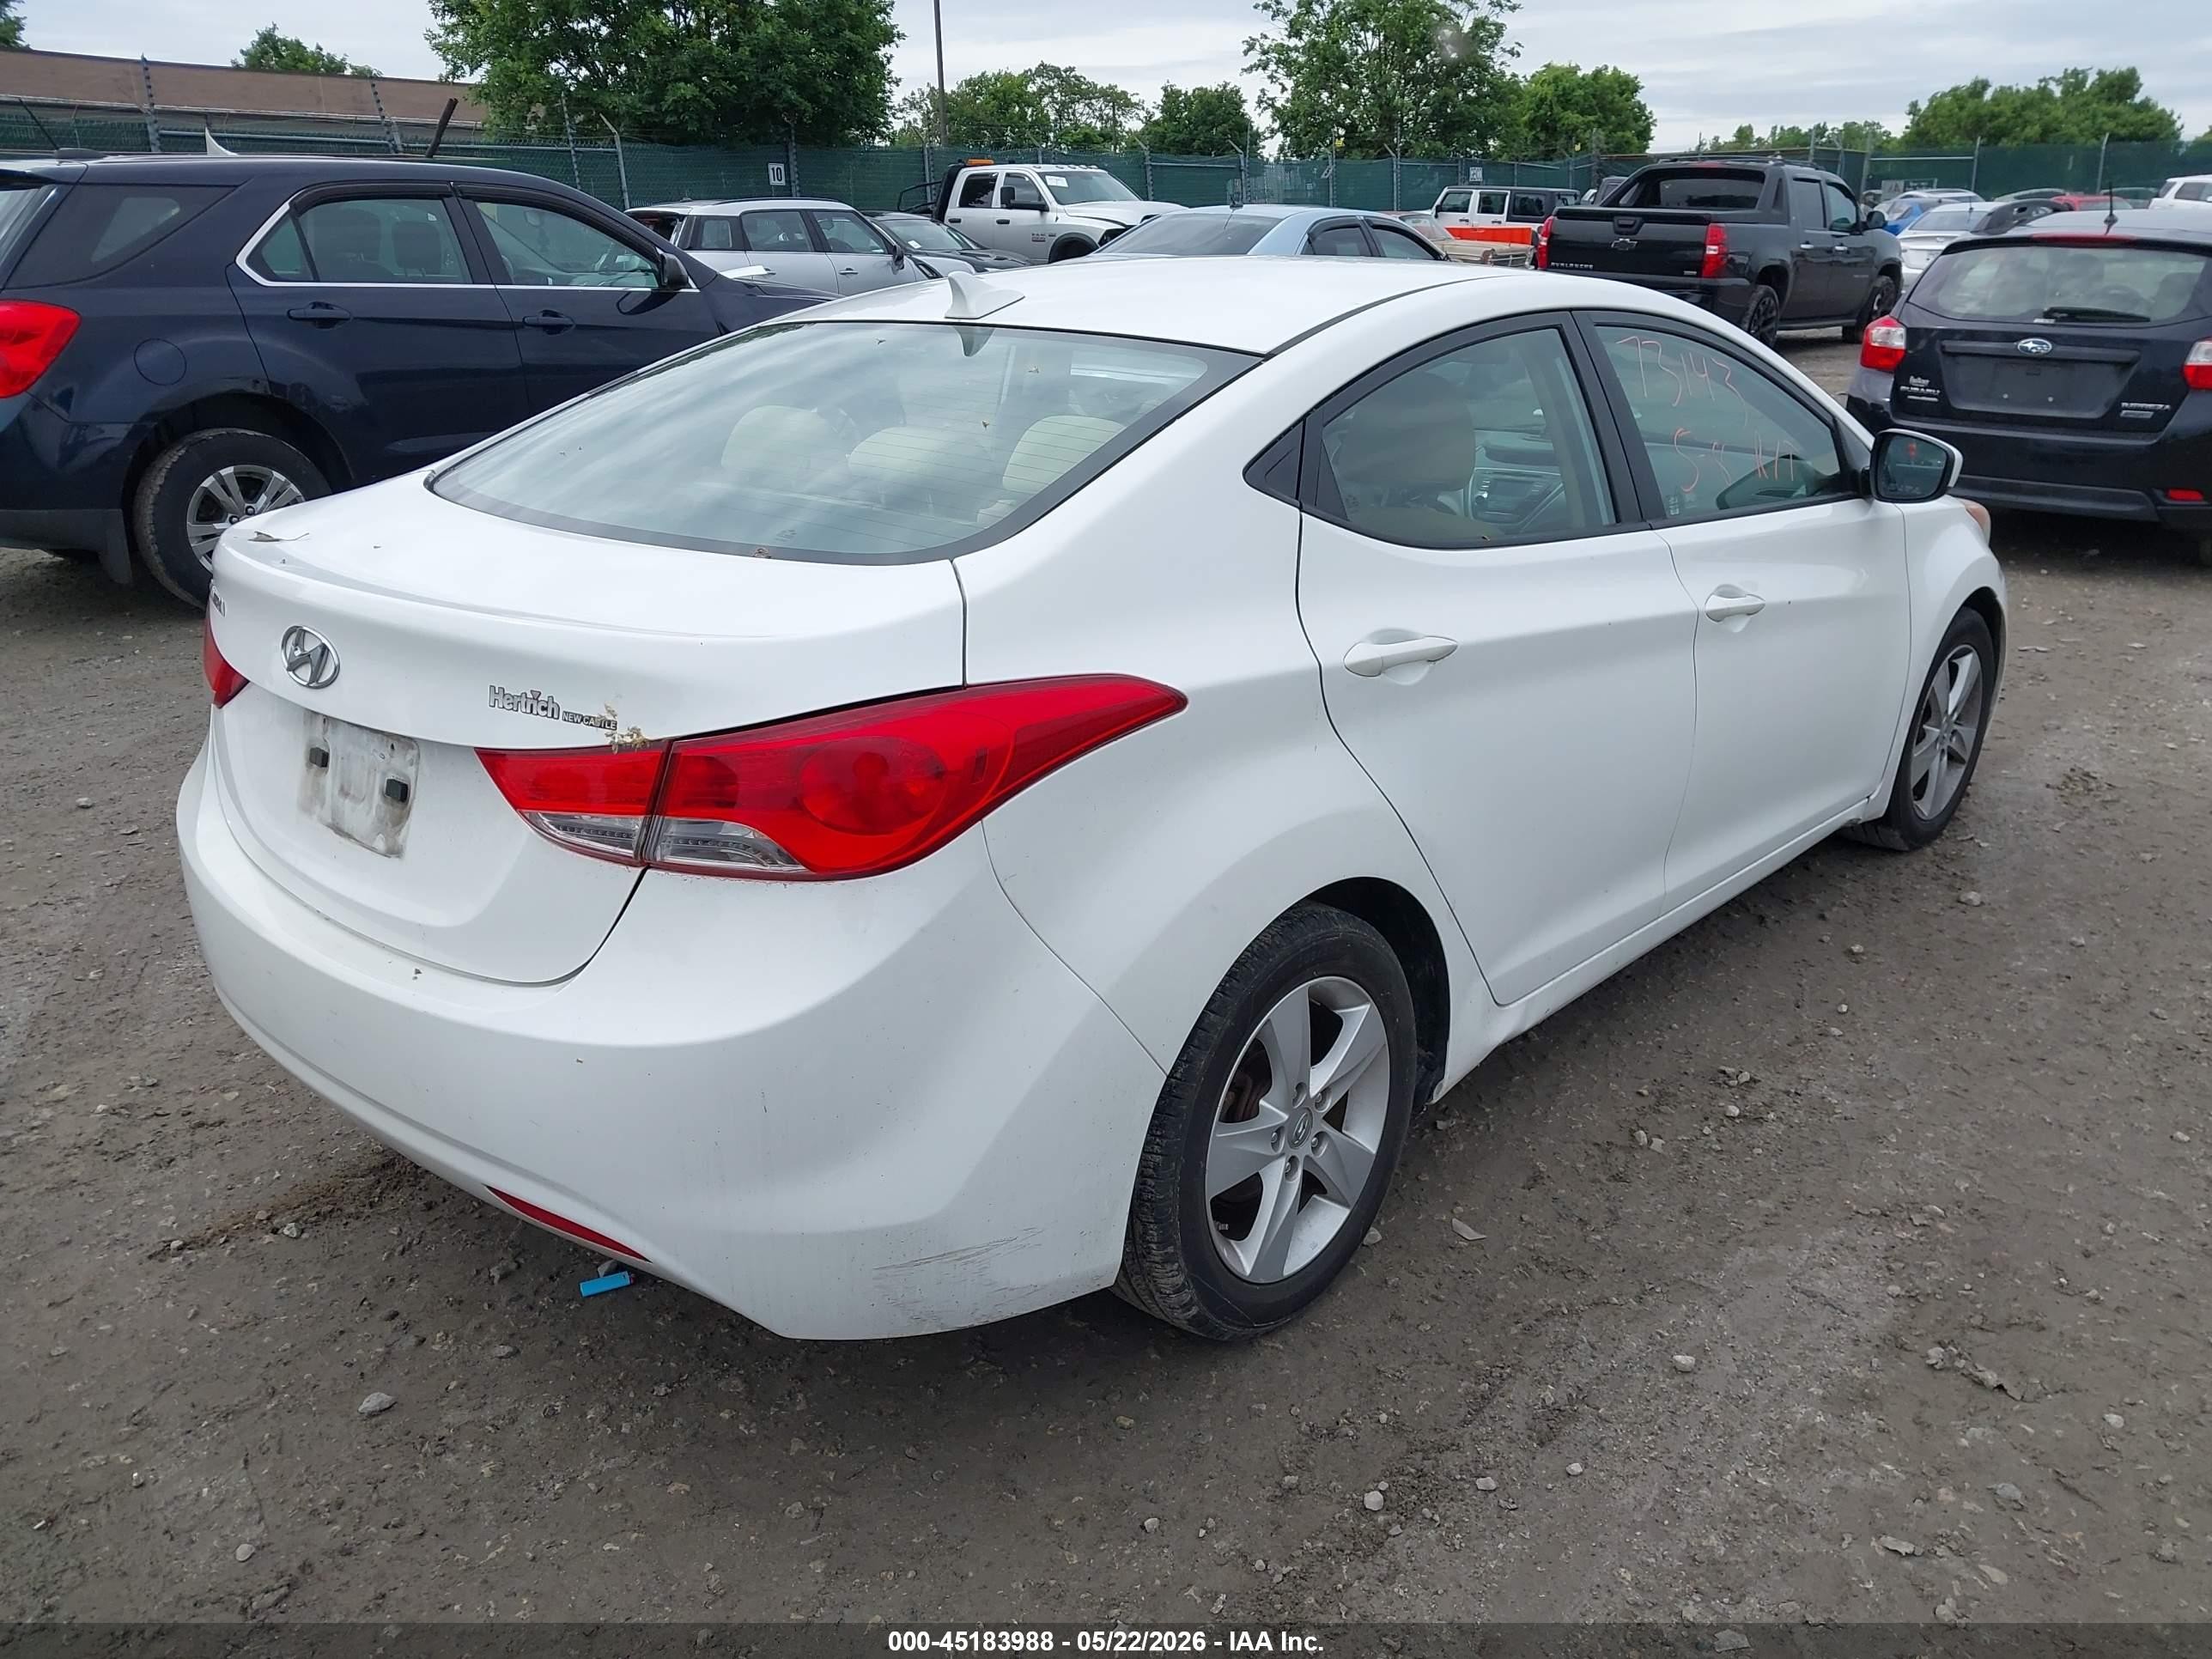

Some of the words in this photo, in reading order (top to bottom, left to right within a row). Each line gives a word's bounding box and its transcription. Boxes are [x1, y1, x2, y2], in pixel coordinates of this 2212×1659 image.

[771, 167, 782, 181] 10
[489, 685, 559, 720] Hertrich
[562, 712, 581, 723] NEW
